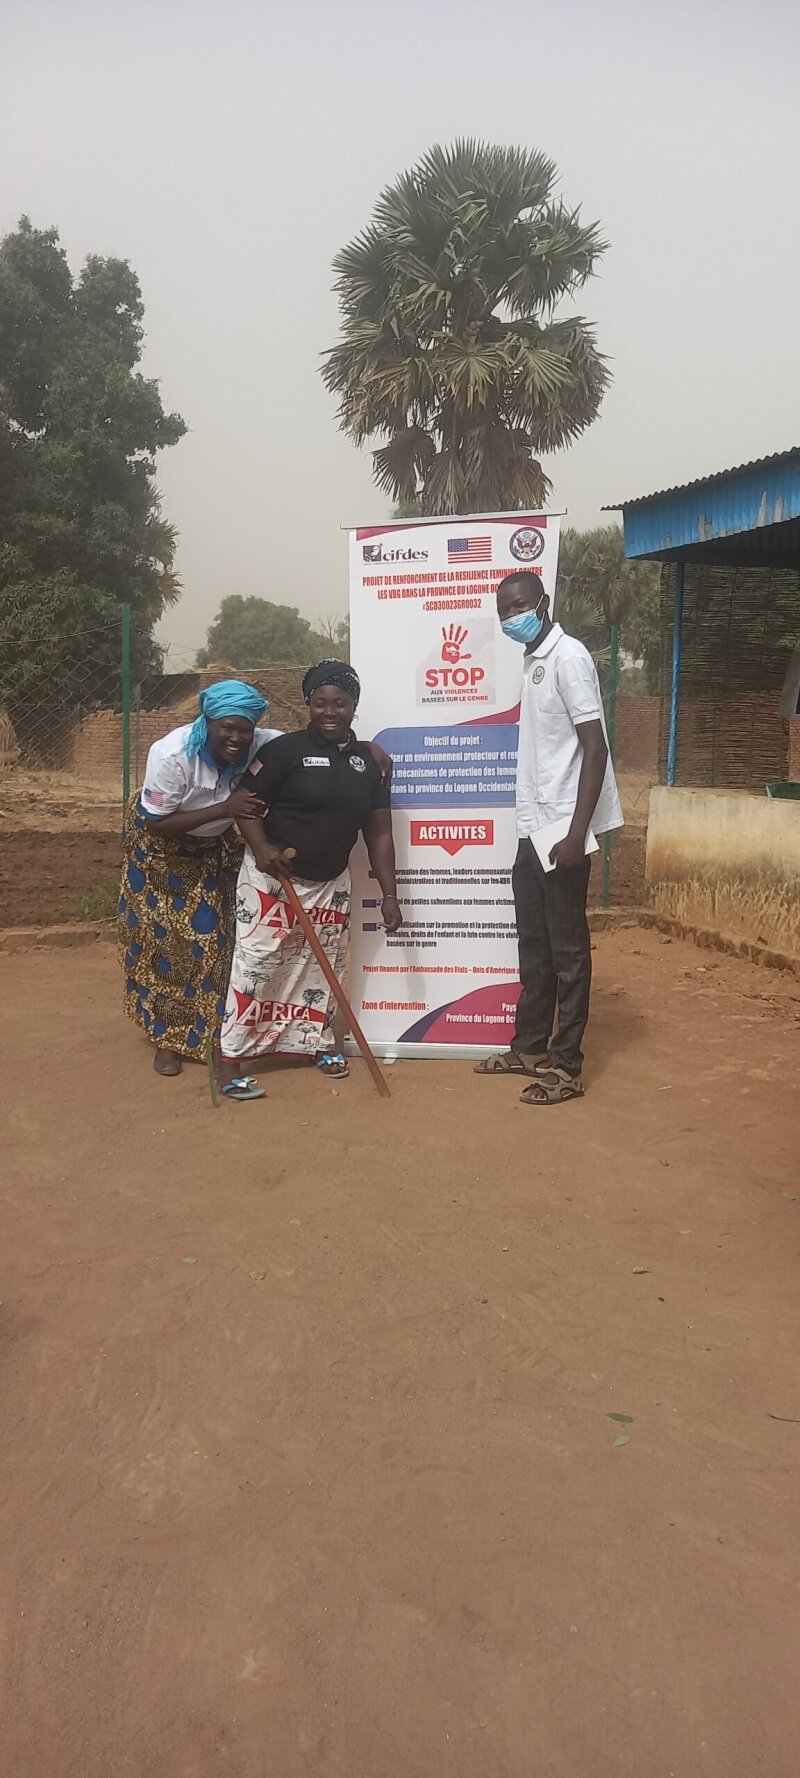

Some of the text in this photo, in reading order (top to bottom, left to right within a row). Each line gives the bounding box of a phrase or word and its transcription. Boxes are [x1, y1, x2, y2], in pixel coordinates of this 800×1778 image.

[383, 548, 429, 561] cifdes
[363, 576, 383, 586] PROJET
[385, 575, 391, 585] DE
[393, 573, 438, 585] RENFORCEMENT
[439, 572, 446, 582] DE
[447, 572, 455, 581] LA
[455, 570, 489, 580] RESILIENCE
[378, 590, 387, 599] LES
[389, 589, 400, 598] VBG
[402, 588, 418, 598] DANS
[419, 587, 426, 597] LA
[427, 585, 456, 597] PROVINCE
[457, 585, 465, 595] DU
[467, 584, 489, 594] LOGONE
[425, 667, 485, 687] STOP
[424, 736, 450, 747] Objectif
[450, 735, 459, 746] du
[460, 735, 480, 746] projet
[405, 754, 413, 762] un
[414, 751, 463, 762] environnement
[464, 751, 499, 762] protecteur
[500, 750, 507, 760] et
[396, 768, 438, 778] mécanismes
[439, 767, 447, 777] de
[448, 767, 482, 778] protection
[483, 766, 496, 776] des
[391, 784, 407, 794] dans
[408, 784, 415, 793] la
[415, 783, 444, 794] province
[445, 783, 453, 793] du
[454, 783, 478, 794] Logone
[419, 825, 486, 840] ACTIVITES
[430, 868, 452, 876] femmes,
[442, 921, 468, 929] promotion
[482, 921, 510, 929] protection
[362, 965, 378, 973] Projet
[410, 965, 443, 973] l'Ambassade
[473, 966, 484, 974] Unis
[362, 1001, 378, 1010] Zone
[379, 1001, 426, 1011] d'intervention
[502, 1003, 517, 1012] Pays
[236, 1000, 310, 1027] AFRICA
[446, 1013, 473, 1023] Province
[474, 1014, 481, 1023] du
[483, 1014, 505, 1024] Logone
